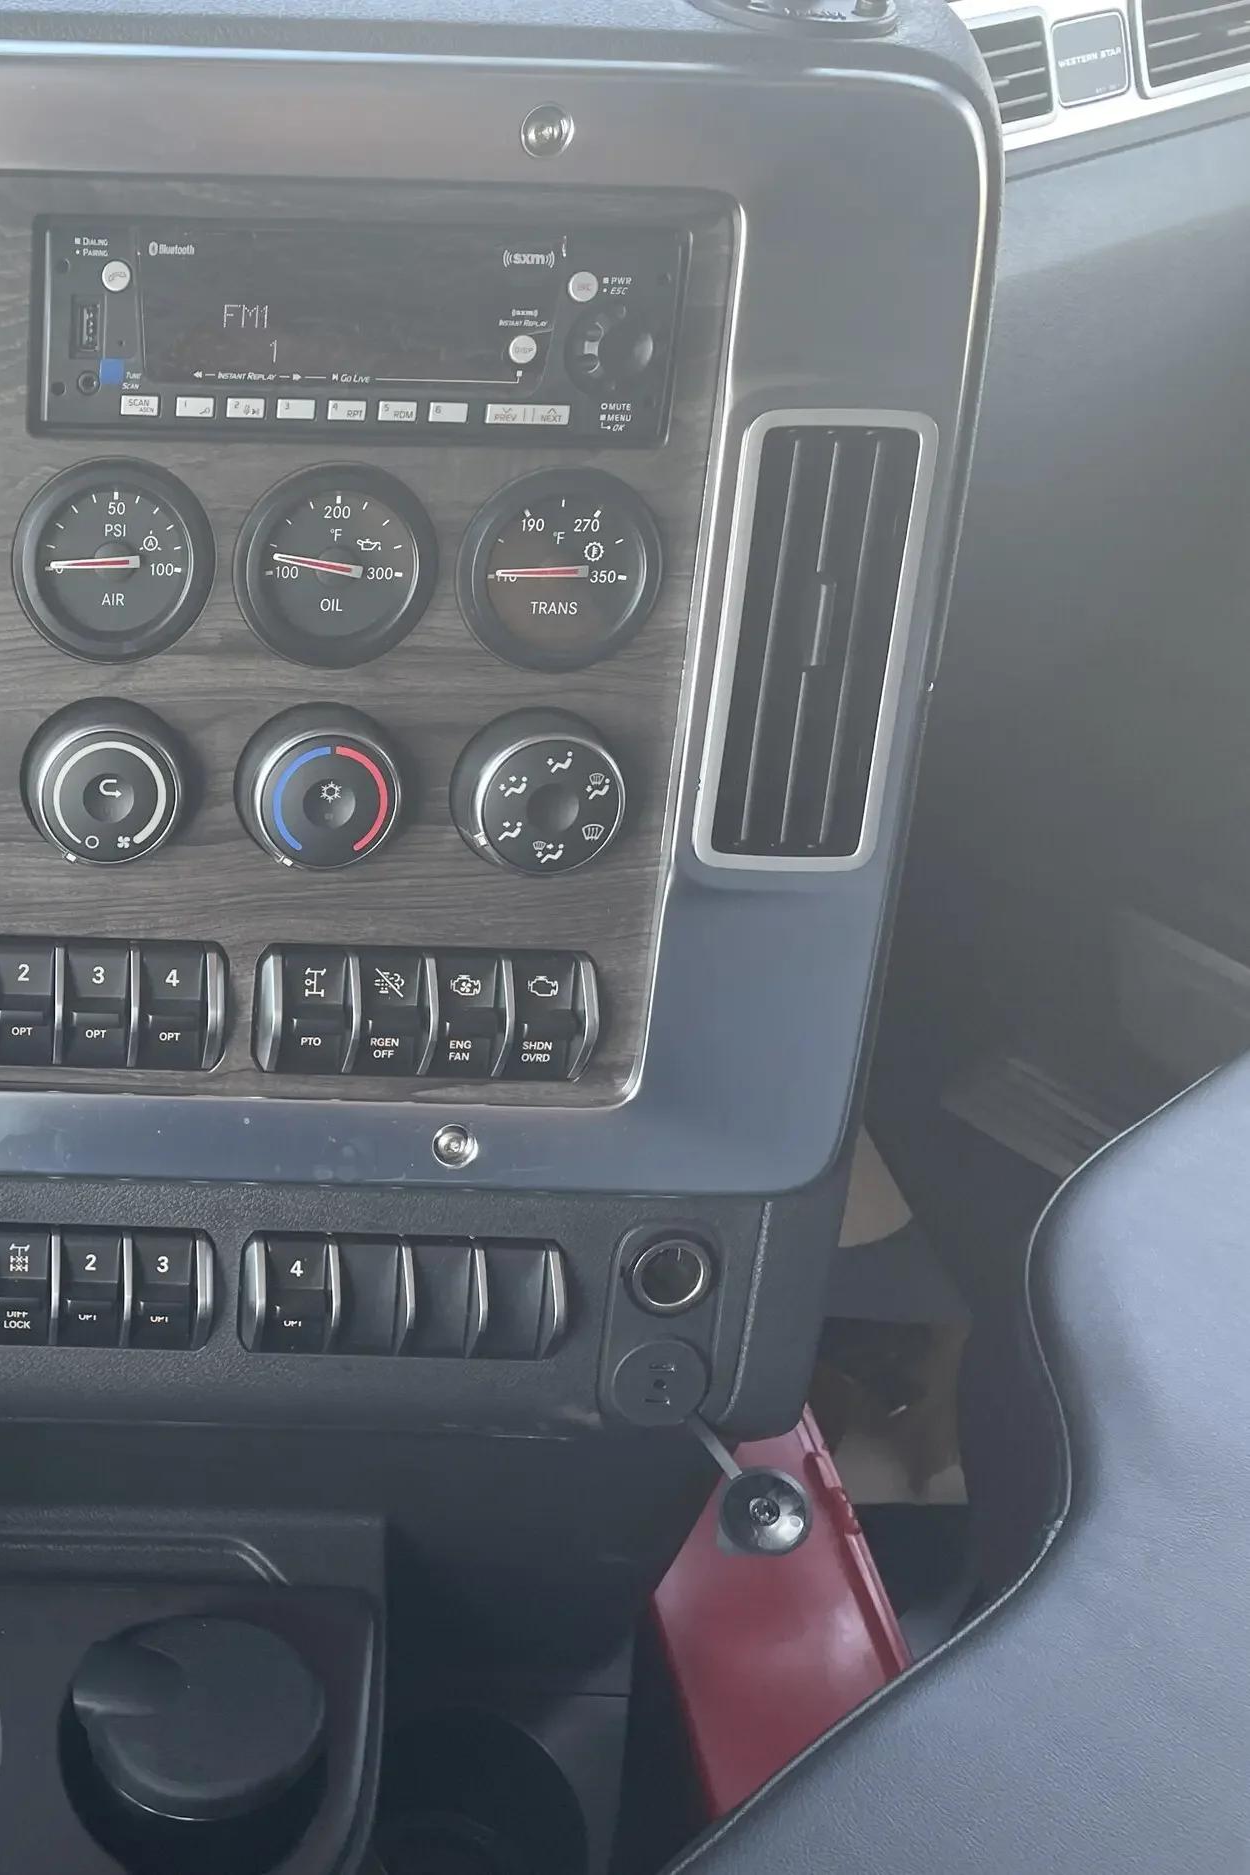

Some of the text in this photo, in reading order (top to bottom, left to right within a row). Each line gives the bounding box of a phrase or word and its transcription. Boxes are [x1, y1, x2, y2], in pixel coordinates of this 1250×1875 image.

[1057, 46, 1121, 68] WESTERN STAR
[611, 277, 632, 285] PWR
[610, 287, 628, 295] ESC
[223, 304, 268, 328] FM1
[269, 339, 277, 363] 1
[128, 399, 150, 407] SCAN
[608, 403, 632, 411] MUTE
[393, 410, 414, 419] RDM
[493, 413, 517, 422] PREV
[540, 415, 563, 423] NEXT
[606, 414, 632, 422] MENU
[612, 424, 626, 432] OK
[108, 502, 126, 515] 50
[323, 506, 351, 519] 200
[104, 524, 126, 537] PSI
[521, 518, 545, 532] 190
[573, 519, 600, 532] 270
[150, 563, 173, 576] 100
[275, 567, 299, 579] 100
[366, 567, 393, 580] 300
[589, 571, 616, 584] 350
[101, 593, 125, 606] AIR
[320, 598, 343, 612] OIL
[530, 602, 578, 615] TRANS
[17, 963, 30, 982] 2
[92, 966, 105, 984] 3
[165, 969, 180, 987] 4
[11, 1026, 33, 1037] OPT
[85, 1029, 107, 1039] OPT
[159, 1032, 181, 1042] OPT
[300, 1036, 322, 1047] PTO
[370, 1037, 400, 1048] RGEN
[449, 1040, 472, 1050] ENG
[521, 1041, 553, 1051] SHDN
[373, 1049, 395, 1059] OFF
[448, 1051, 470, 1061] FAN
[520, 1052, 551, 1063] OVRD
[84, 1254, 97, 1271] 2
[156, 1255, 169, 1273] 3
[289, 1260, 304, 1277] 4
[3, 1320, 31, 1329] LOCK
